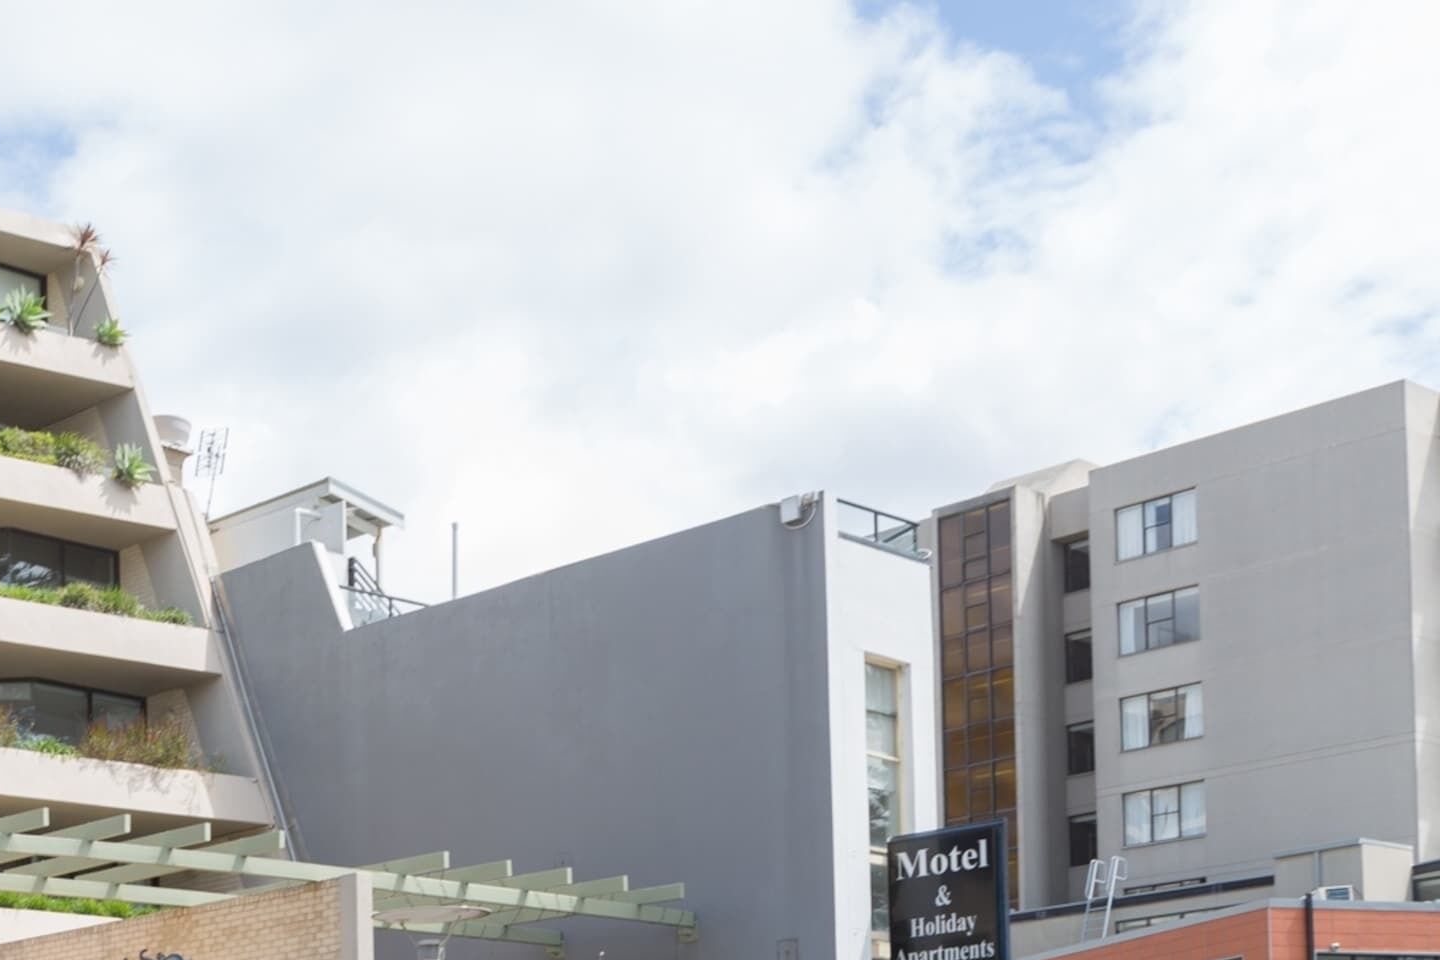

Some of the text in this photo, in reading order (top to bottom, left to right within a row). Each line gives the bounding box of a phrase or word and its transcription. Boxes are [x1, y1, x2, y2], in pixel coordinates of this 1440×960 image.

[896, 839, 989, 880] Motel
[934, 884, 952, 906] &
[910, 912, 977, 938] Holiday
